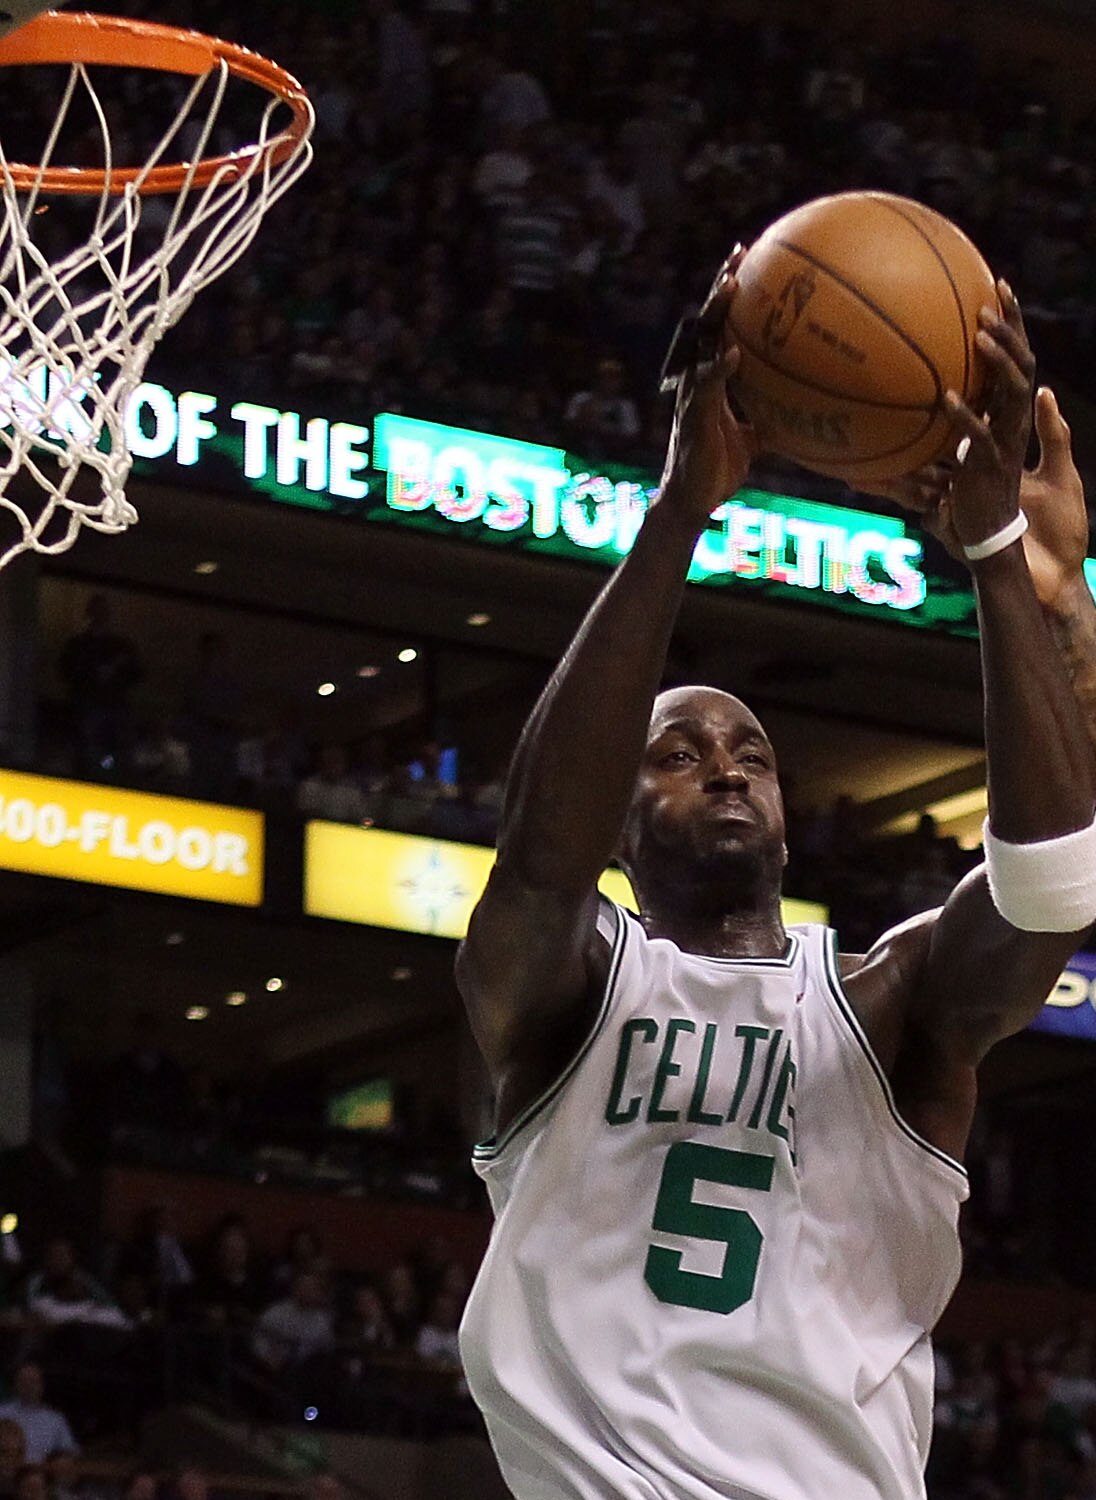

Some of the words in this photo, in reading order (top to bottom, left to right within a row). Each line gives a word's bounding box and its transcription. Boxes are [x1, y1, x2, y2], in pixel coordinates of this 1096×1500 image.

[125, 382, 218, 466] OF
[231, 402, 369, 499] THE
[0, 794, 249, 877] 00-FLOOR
[644, 1141, 775, 1315] 5
